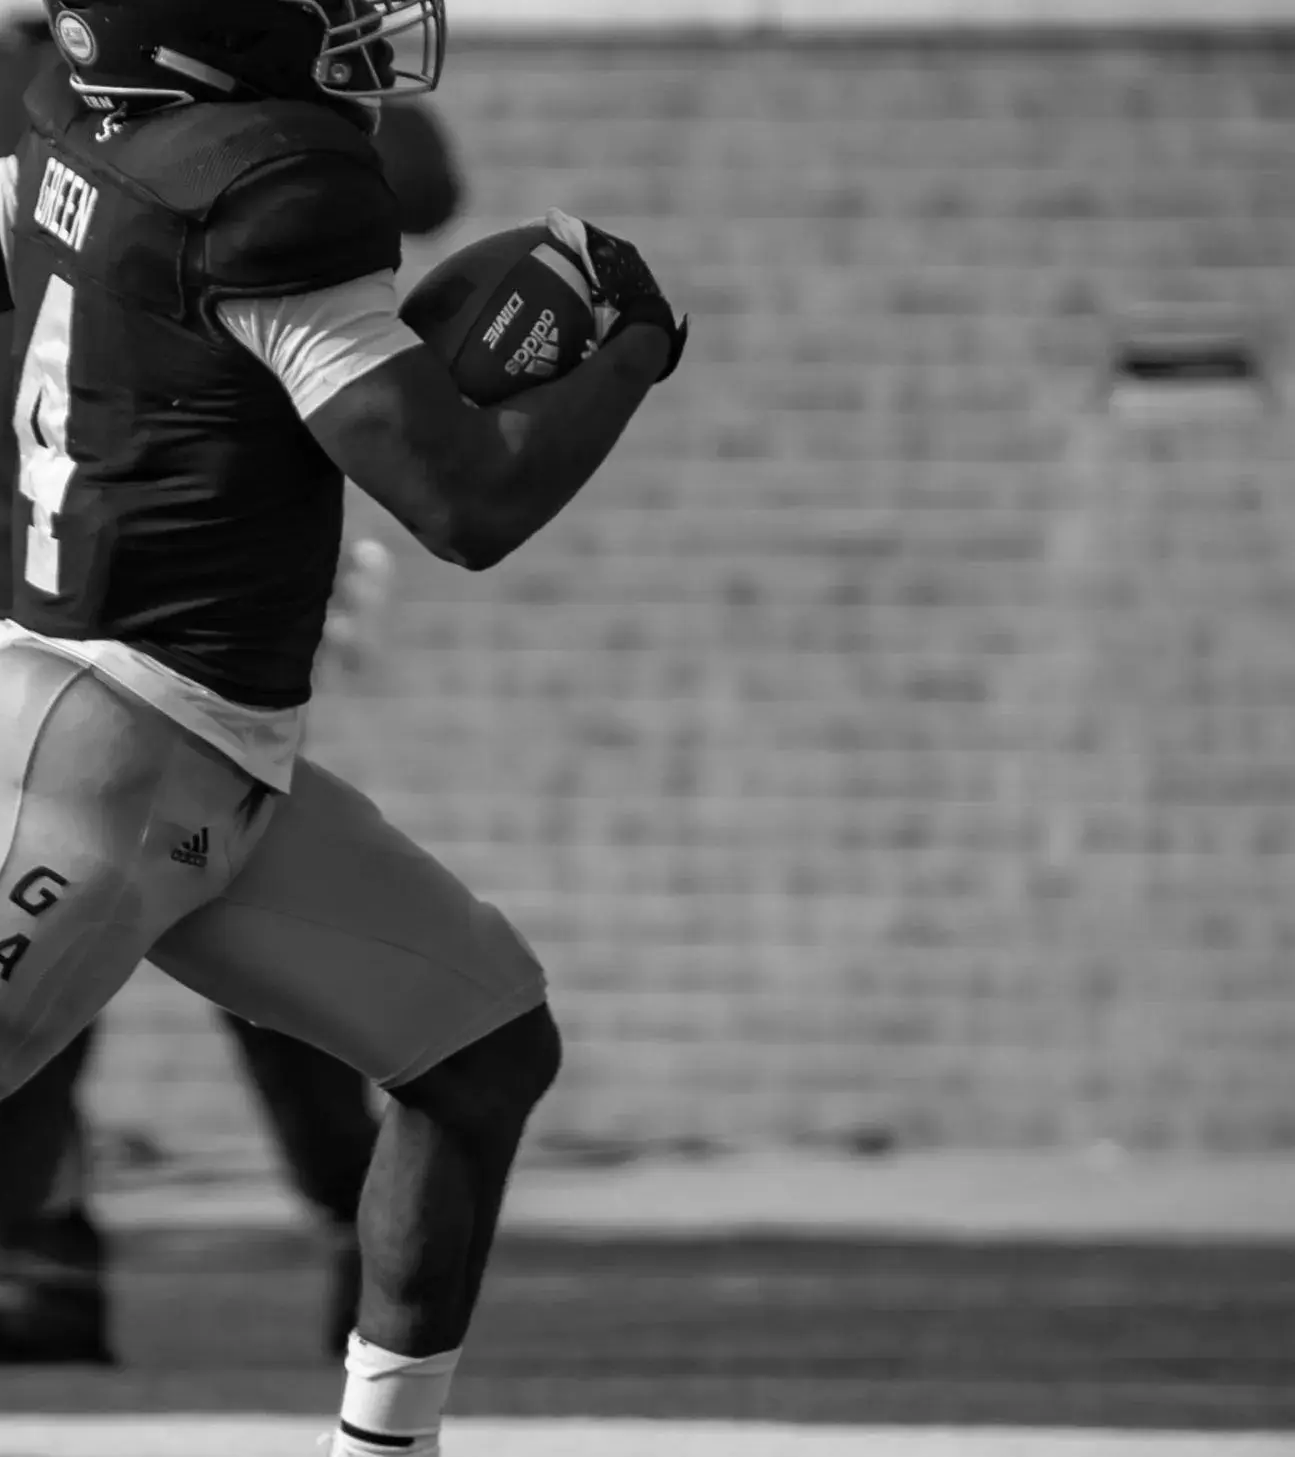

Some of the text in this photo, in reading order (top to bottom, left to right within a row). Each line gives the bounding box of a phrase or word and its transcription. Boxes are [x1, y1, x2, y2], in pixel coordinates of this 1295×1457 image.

[33, 157, 99, 252] GREEN
[482, 291, 524, 349] DIME
[505, 308, 554, 375] adidas
[12, 273, 78, 596] 4
